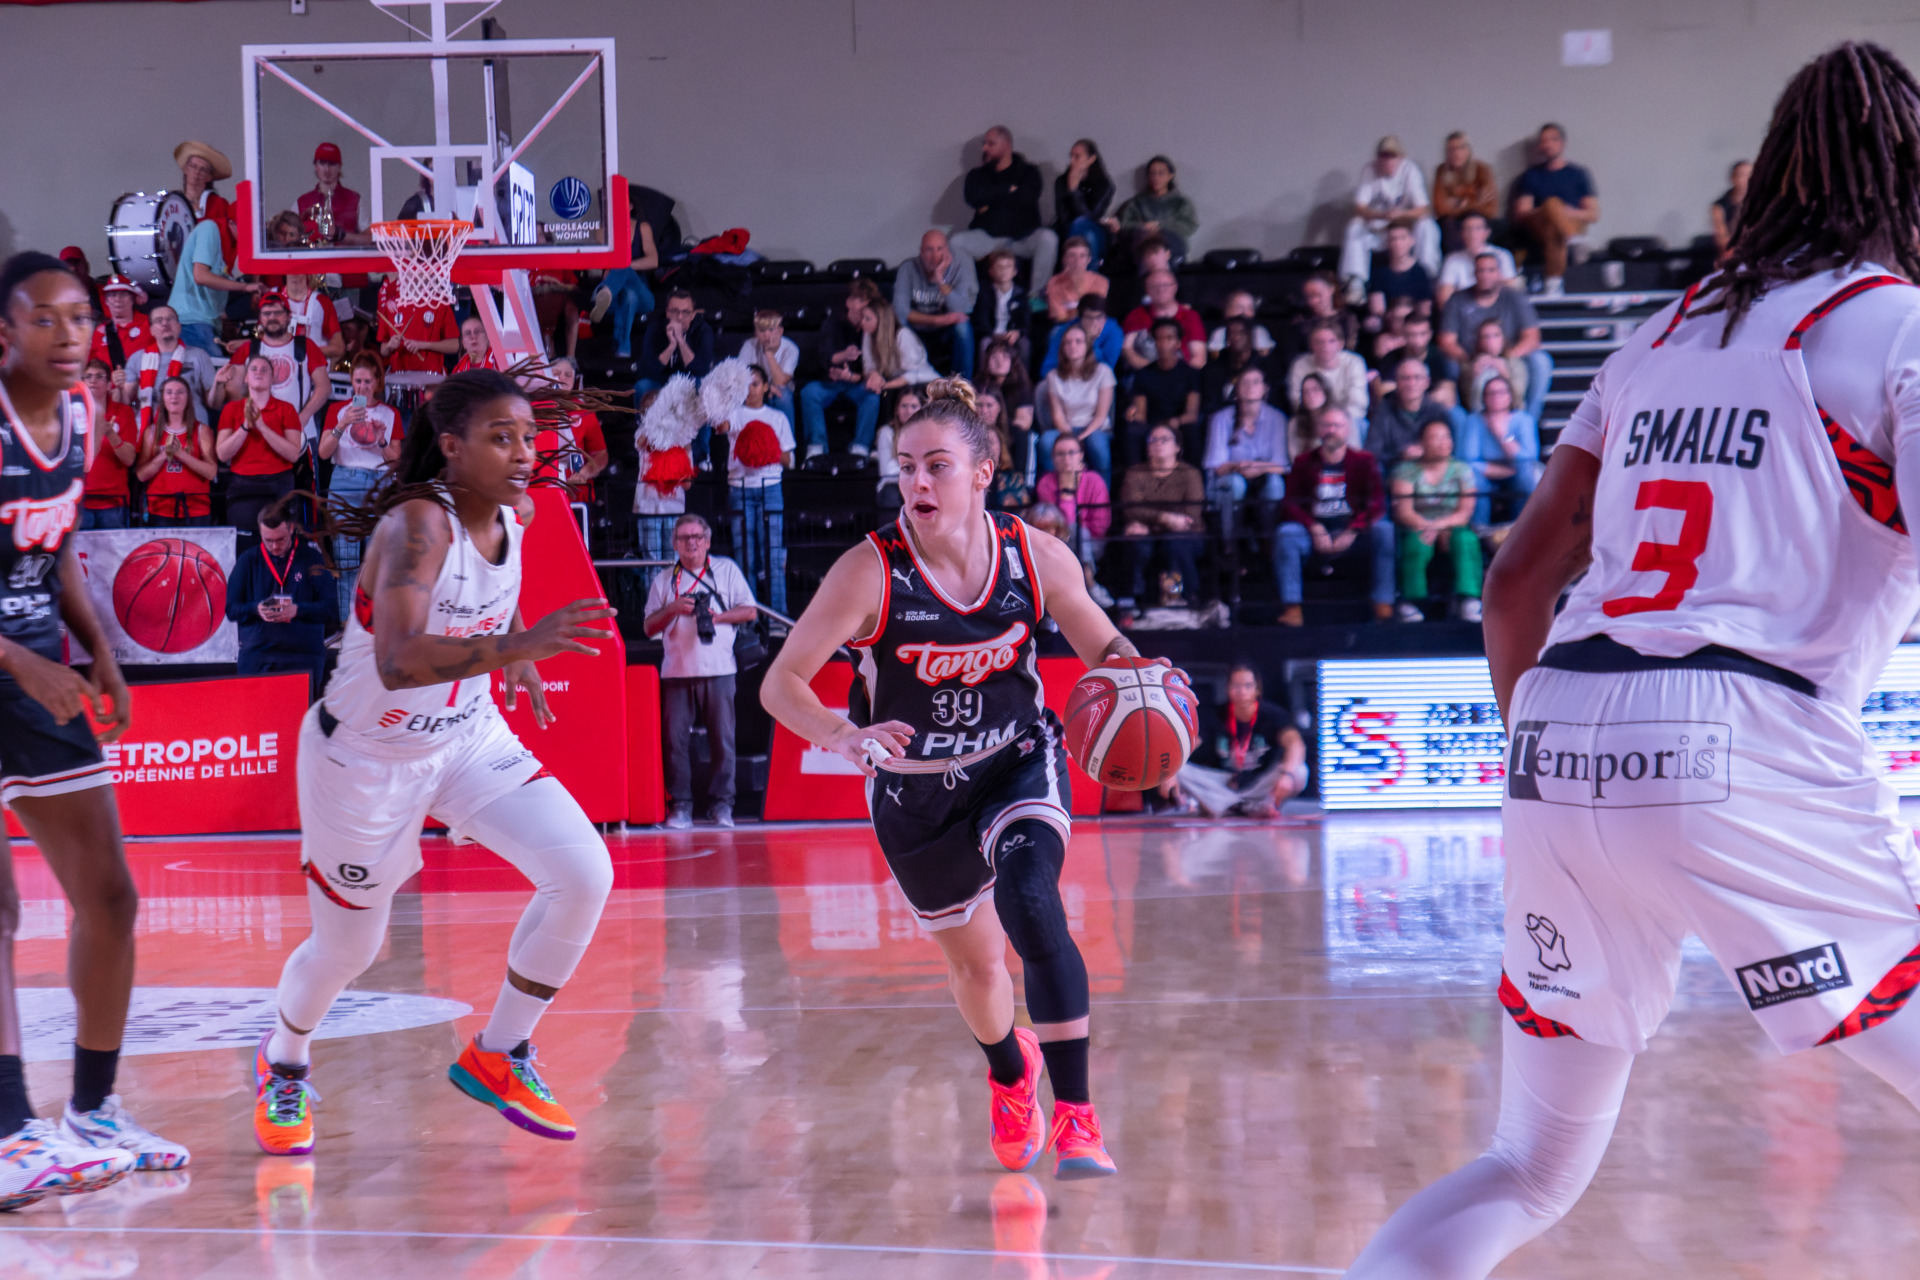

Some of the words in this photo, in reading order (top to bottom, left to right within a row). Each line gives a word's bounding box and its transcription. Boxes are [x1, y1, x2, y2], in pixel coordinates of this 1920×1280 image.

[543, 220, 601, 233] EUROLEAGUE
[555, 231, 590, 240] WOMEN
[1624, 407, 1771, 470] SMALLS
[1602, 478, 1715, 619] 3
[905, 613, 940, 621] BOURGES
[896, 621, 1029, 687] Tango
[932, 687, 983, 727] 39
[921, 720, 1018, 756] PHM
[201, 764, 225, 779] DE
[230, 760, 278, 777] LILLE
[1742, 945, 1842, 998] Nord
